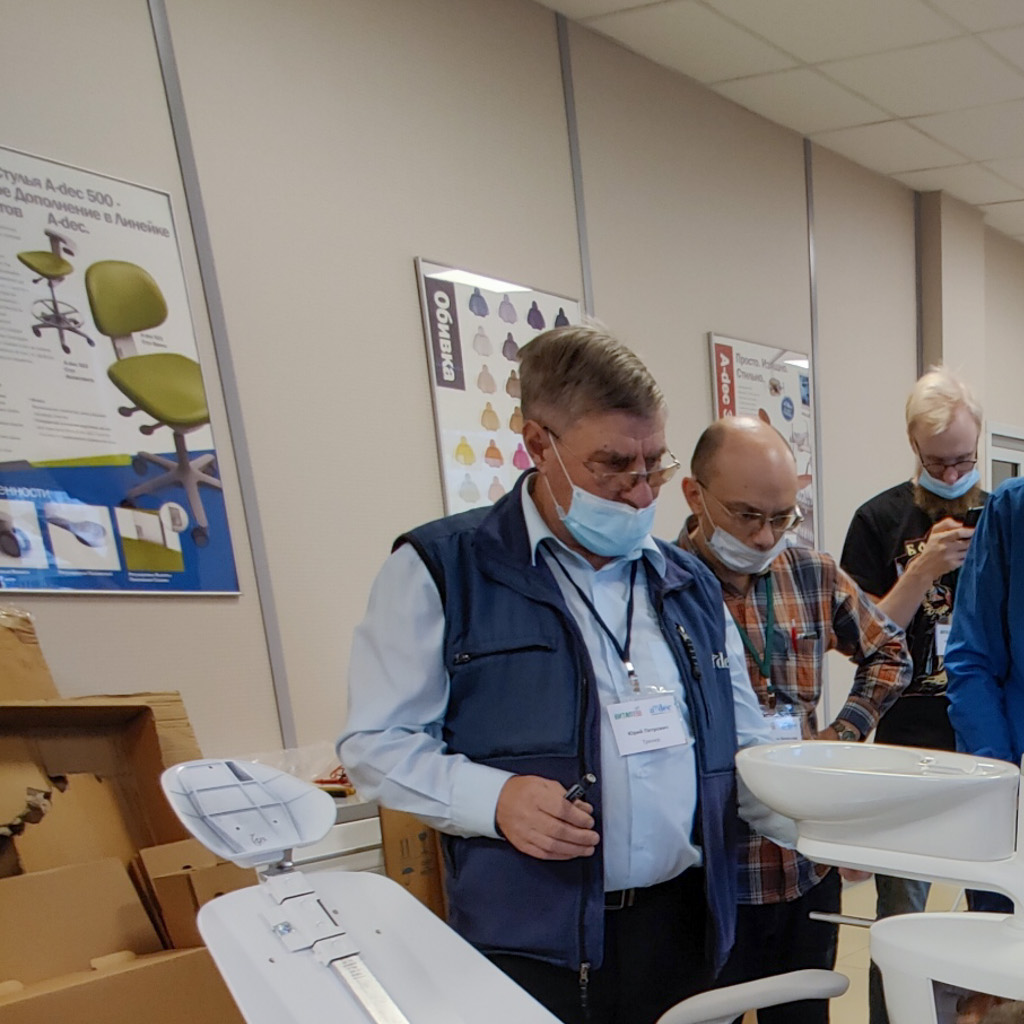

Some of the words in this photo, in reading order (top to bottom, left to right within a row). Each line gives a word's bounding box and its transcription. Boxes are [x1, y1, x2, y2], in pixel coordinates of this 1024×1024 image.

[14, 187, 101, 221] Дополнение
[115, 213, 171, 238] Линейке
[45, 178, 84, 200] A-dec
[86, 189, 114, 208] 500
[434, 290, 456, 383] Обивка
[735, 352, 760, 367] Просто.
[719, 353, 732, 405] A-dec
